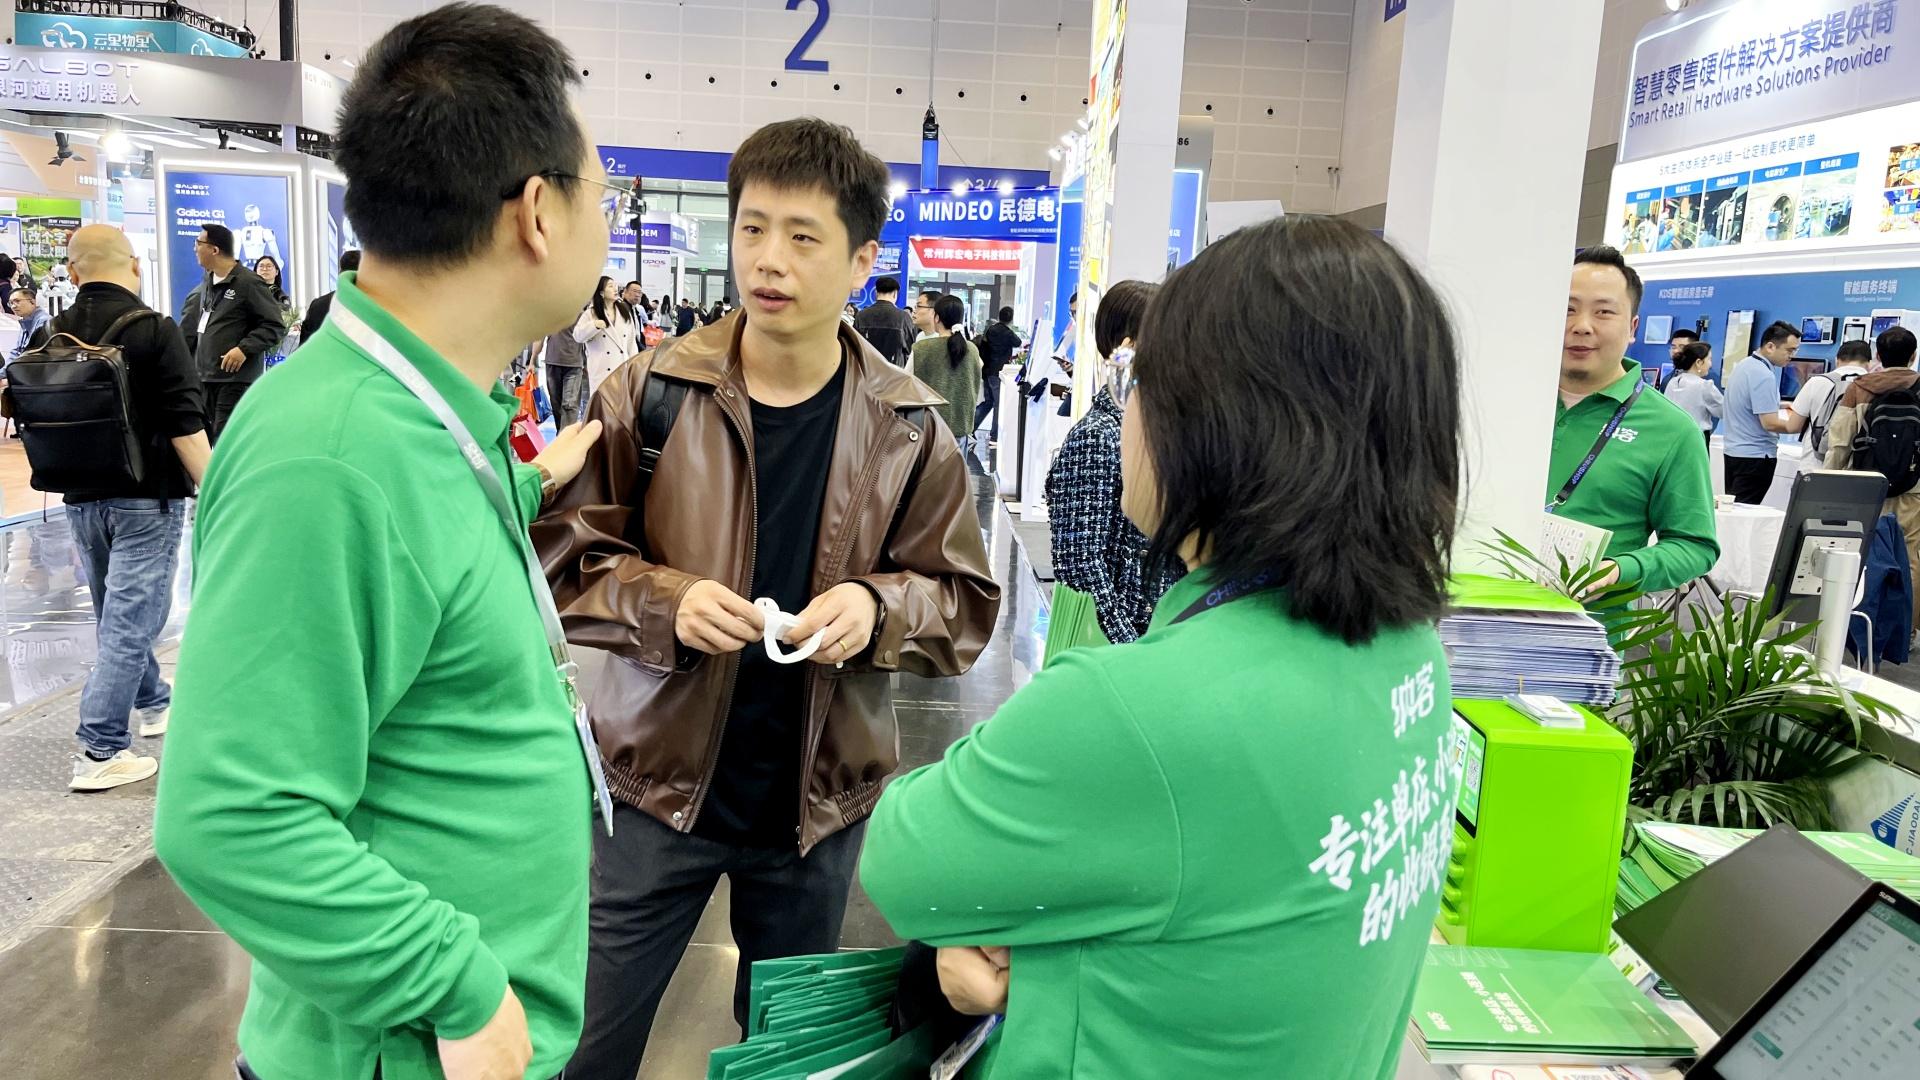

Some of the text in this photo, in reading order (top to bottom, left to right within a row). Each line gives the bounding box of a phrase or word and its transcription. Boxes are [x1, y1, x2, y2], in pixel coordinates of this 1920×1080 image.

[785, 0, 830, 72] 2
[1633, 0, 1897, 106] 智慧零售硬件解决方案提供商
[1629, 43, 1891, 128] Smart Retail Hardware Solutions Provider
[606, 157, 616, 173] 2
[919, 200, 993, 222] MINDEO
[999, 198, 1061, 223] 民德电
[1843, 279, 1898, 295] 智能服务终端
